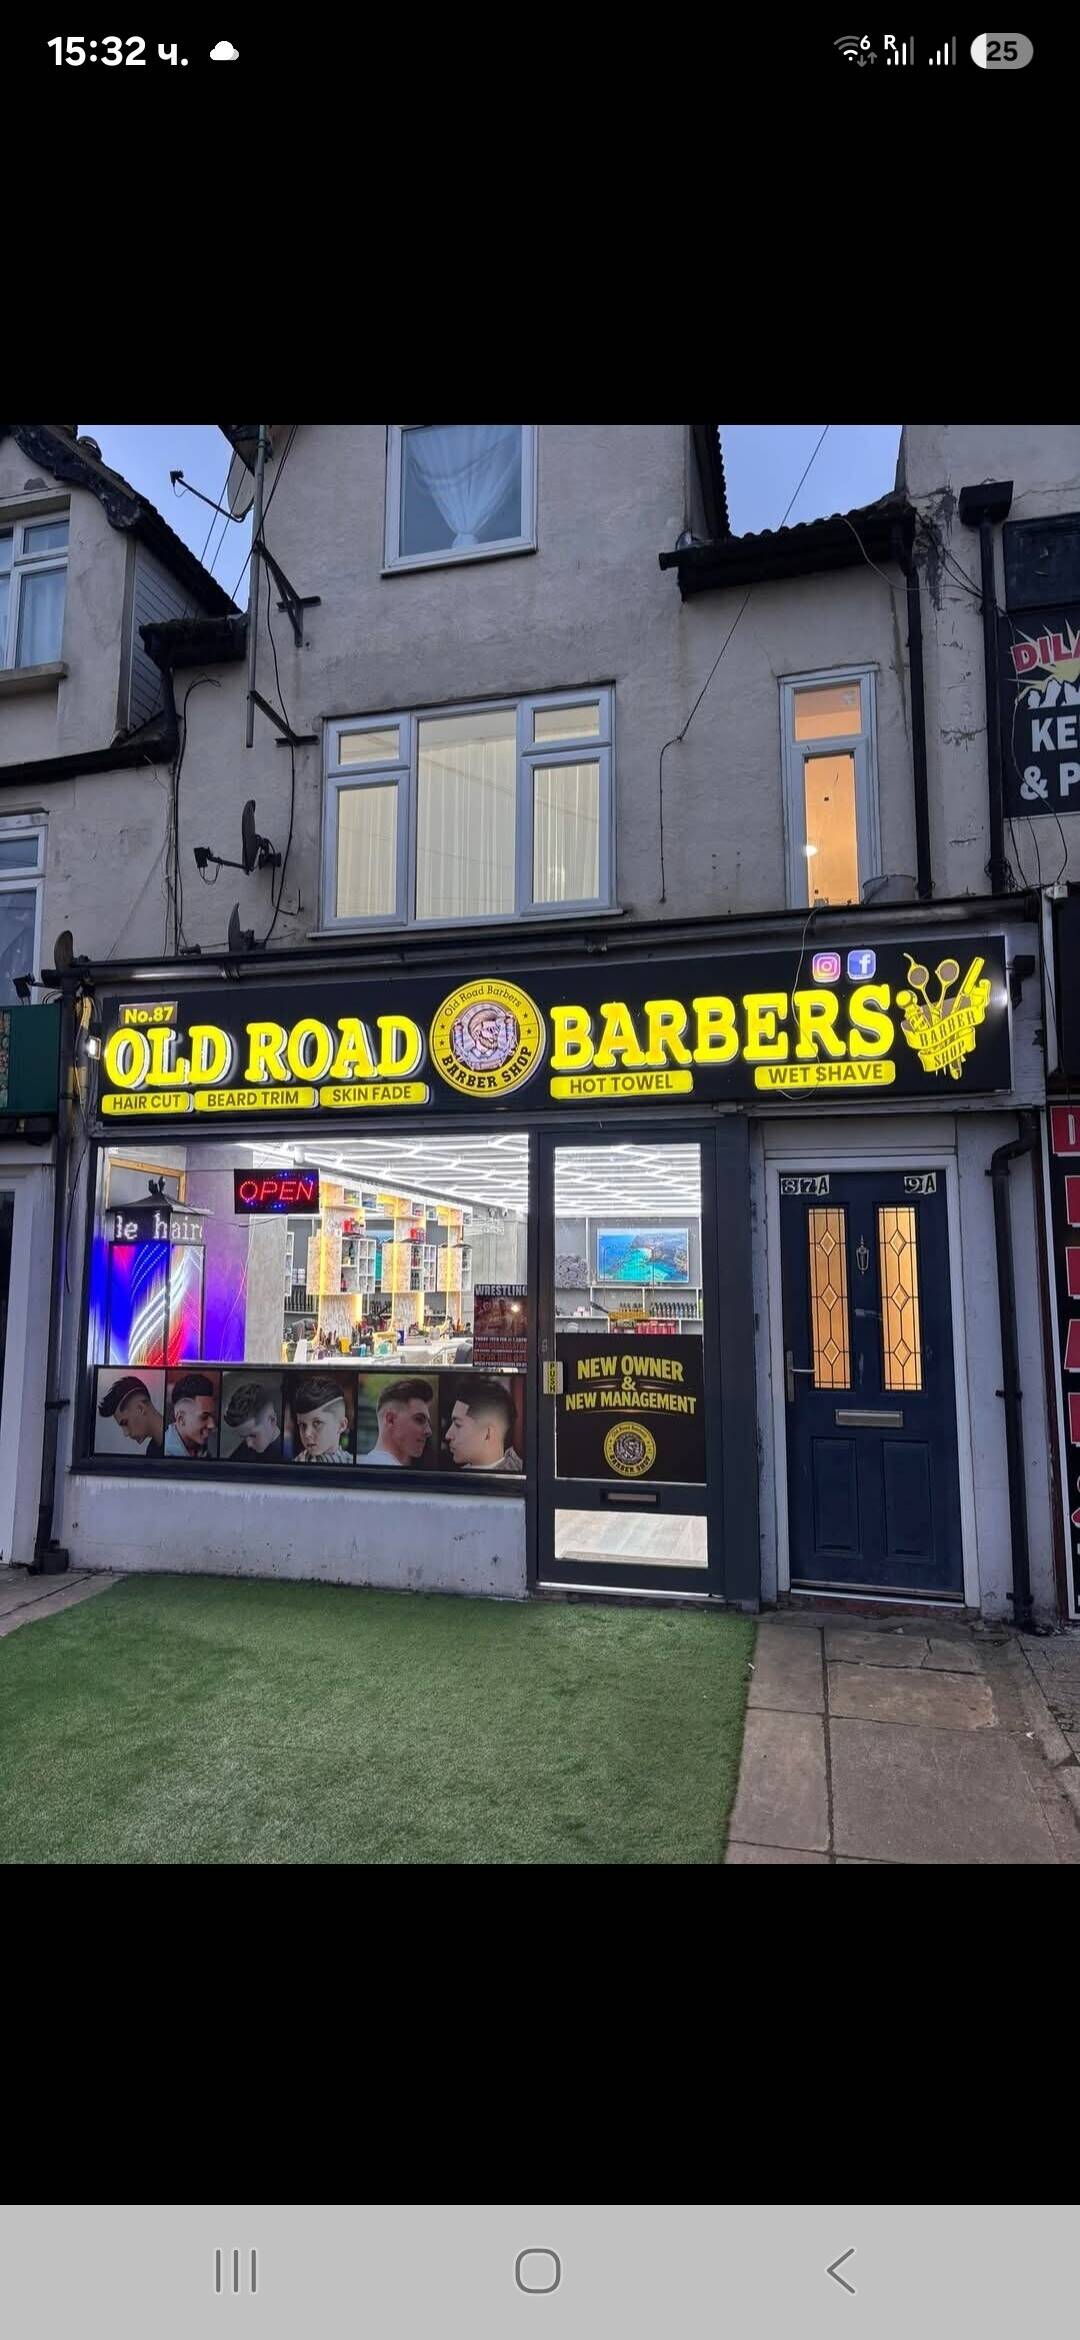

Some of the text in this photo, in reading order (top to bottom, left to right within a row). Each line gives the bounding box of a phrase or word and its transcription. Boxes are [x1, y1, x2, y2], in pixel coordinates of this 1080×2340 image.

[1010, 629, 1080, 674] DIL
[1031, 715, 1080, 752] KE
[1020, 765, 1048, 800] &
[445, 985, 522, 1017] Old Road Barbers
[124, 1006, 174, 1024] No.87
[105, 983, 896, 1088] OLD ROAD BARBERS
[442, 1046, 531, 1088] BARBER SHOP
[769, 1063, 883, 1084] WET SHAVE
[332, 1085, 411, 1102] SKIN FADE
[570, 1073, 673, 1094] HOT TOWEL
[113, 1094, 181, 1111] HAIR CUT
[207, 1090, 299, 1107] BEARD TRIM
[240, 1180, 314, 1201] OPEN
[782, 1175, 829, 1196] 87A
[475, 1285, 528, 1296] WRESTLING
[577, 1355, 684, 1382] NEW OWNER
[621, 1375, 637, 1391] &
[565, 1391, 697, 1415] NEW MANAGEMENT
